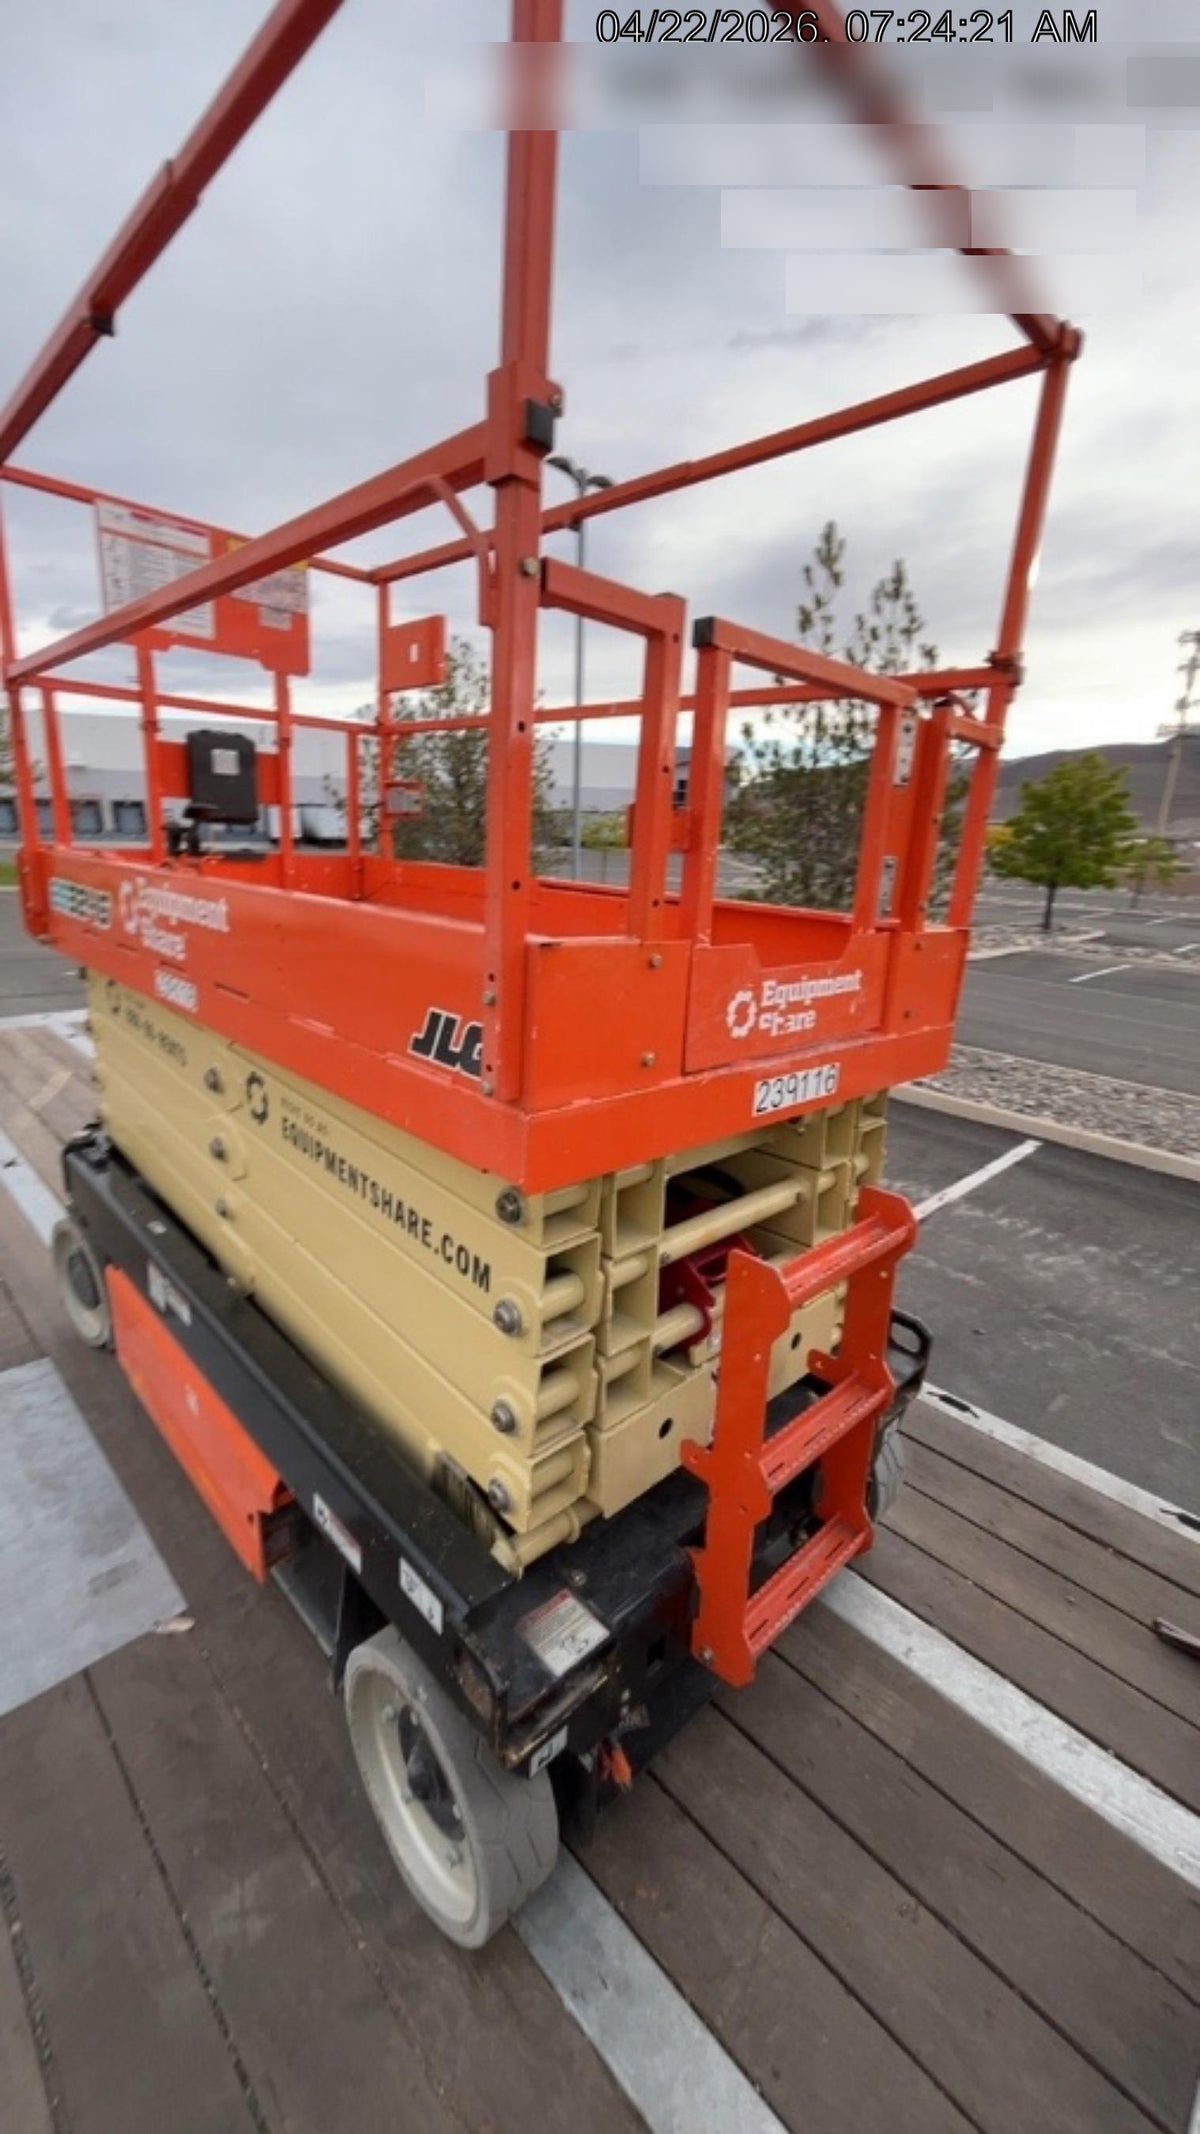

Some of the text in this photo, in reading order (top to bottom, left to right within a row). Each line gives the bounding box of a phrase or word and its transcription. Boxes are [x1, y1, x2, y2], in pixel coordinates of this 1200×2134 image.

[759, 969, 863, 1010] Equipment
[755, 1064, 836, 1113] 239116
[281, 1118, 491, 1293] EQUIPMENTSHARE.COM
